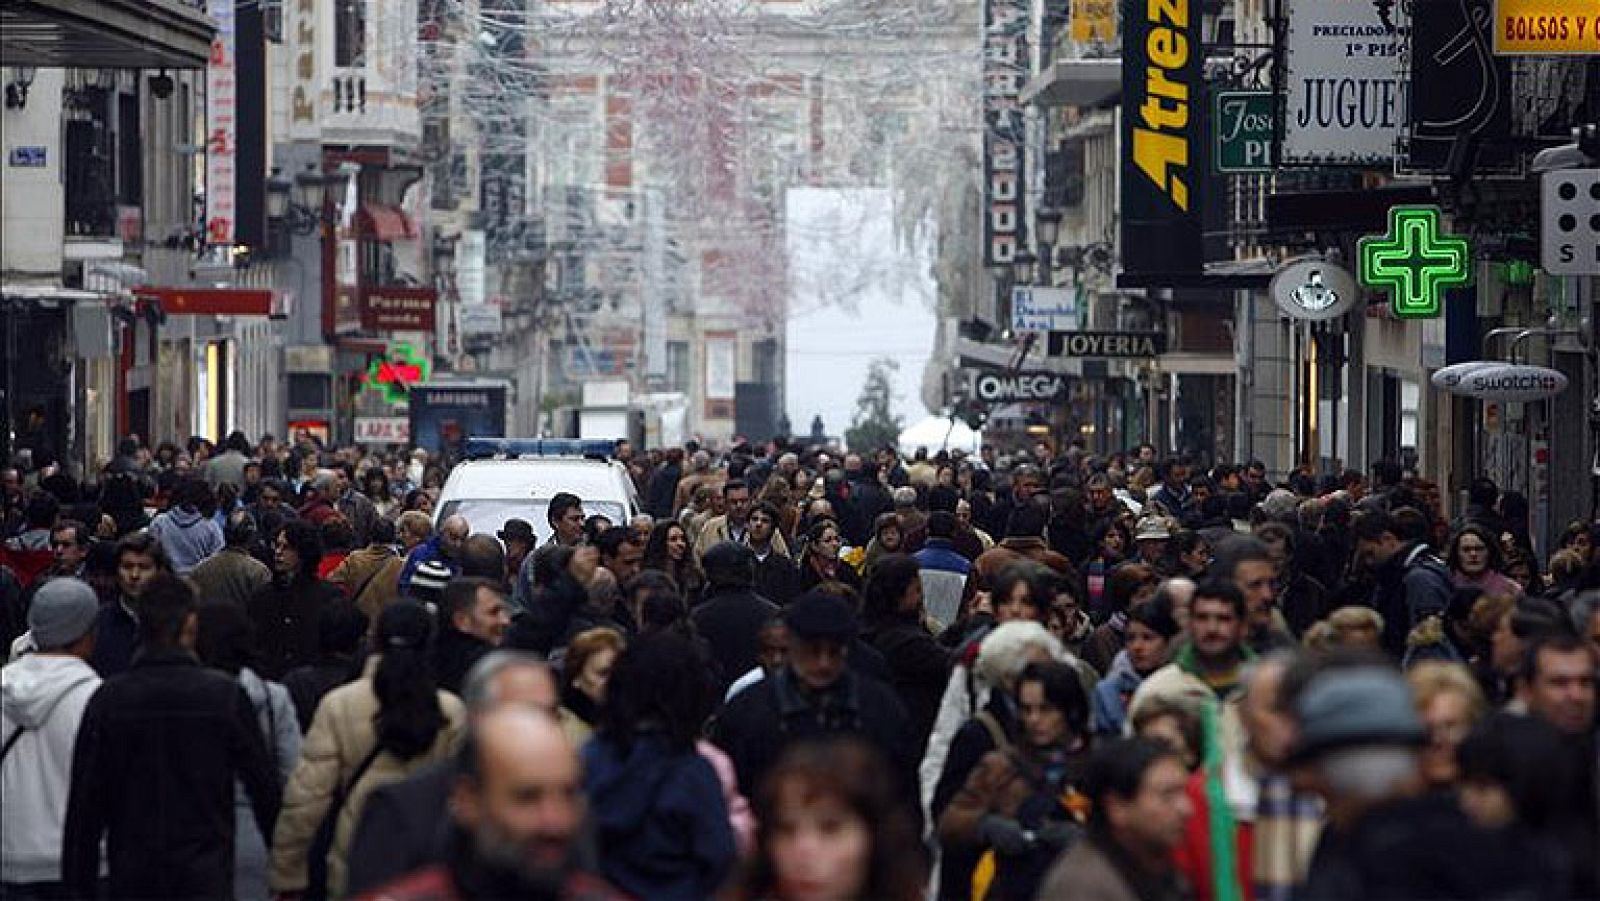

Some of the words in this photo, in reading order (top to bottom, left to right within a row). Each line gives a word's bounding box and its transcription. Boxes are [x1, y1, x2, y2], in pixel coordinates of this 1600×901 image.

[1506, 16, 1568, 40] BOLSOS
[1576, 16, 1586, 40] Y
[991, 138, 1017, 261] 2000
[1062, 336, 1154, 356] JOYERIA
[980, 376, 1065, 398] OMEGA
[1473, 374, 1541, 391] swatch
